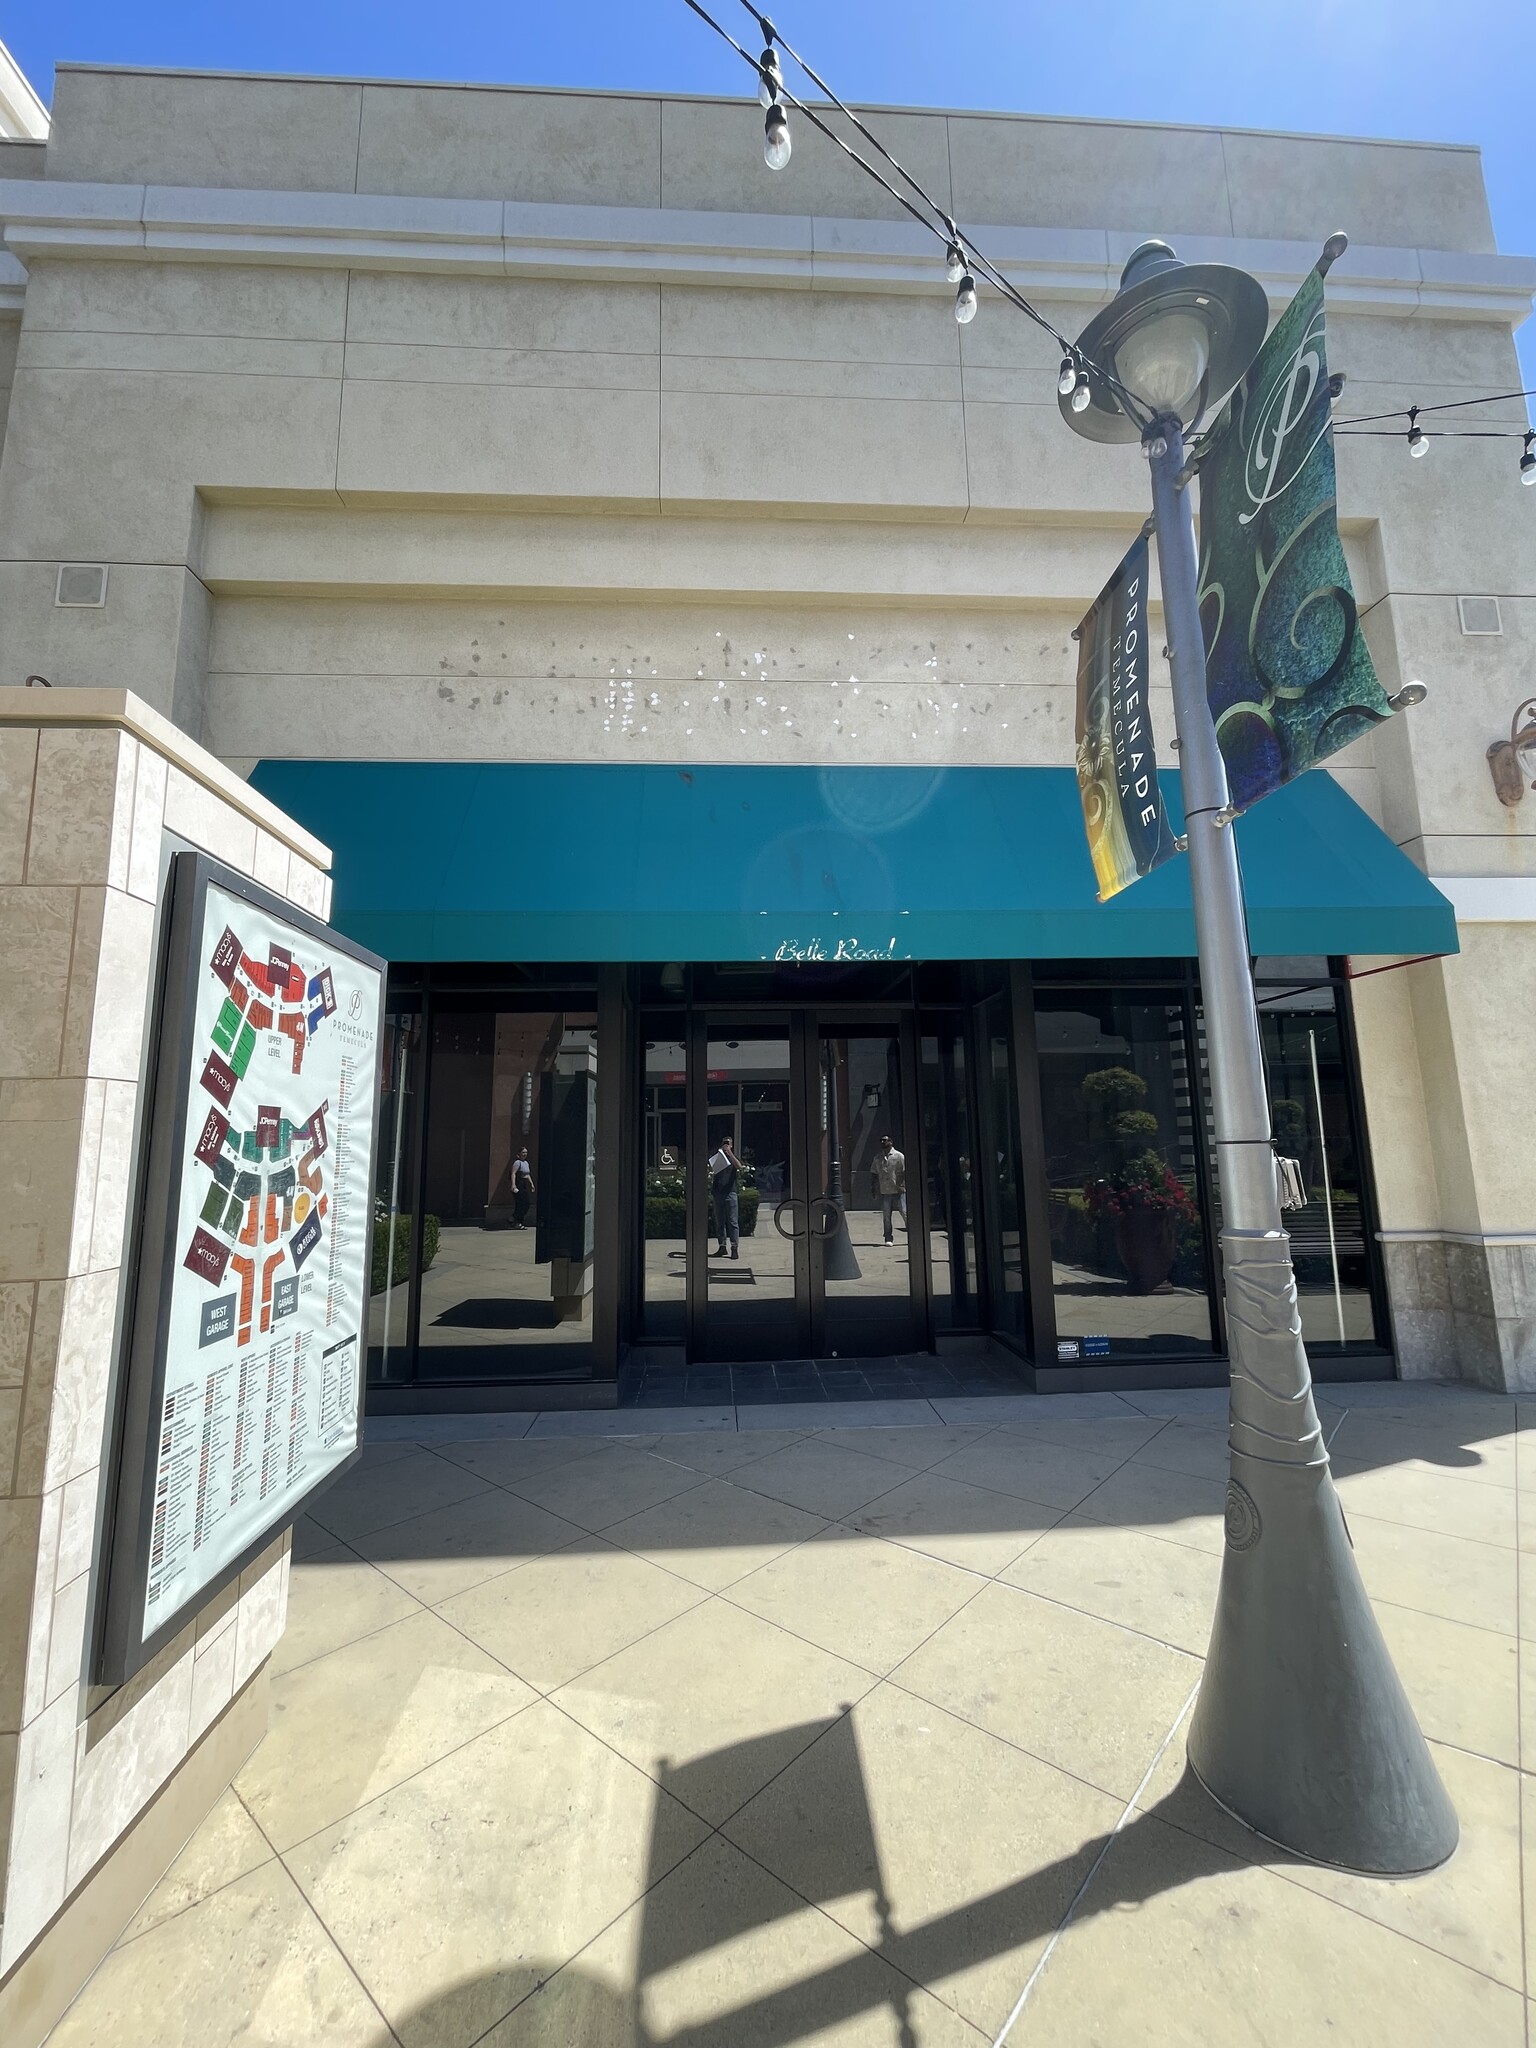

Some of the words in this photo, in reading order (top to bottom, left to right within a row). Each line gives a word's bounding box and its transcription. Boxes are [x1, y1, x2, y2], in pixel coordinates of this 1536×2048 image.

[1125, 576, 1157, 827] PROMENADE
[1112, 635, 1130, 798] TEMECULA
[332, 1019, 374, 1041] PROMENADE
[267, 1034, 282, 1047] UPPER
[267, 1047, 281, 1058] LEVEL
[301, 1270, 315, 1283] LOWER
[281, 1283, 293, 1296] EAST
[301, 1283, 313, 1295] LEVEL
[277, 1294, 295, 1310] GARAGE
[210, 1304, 228, 1321] WEST
[206, 1318, 230, 1337] GARAGE
